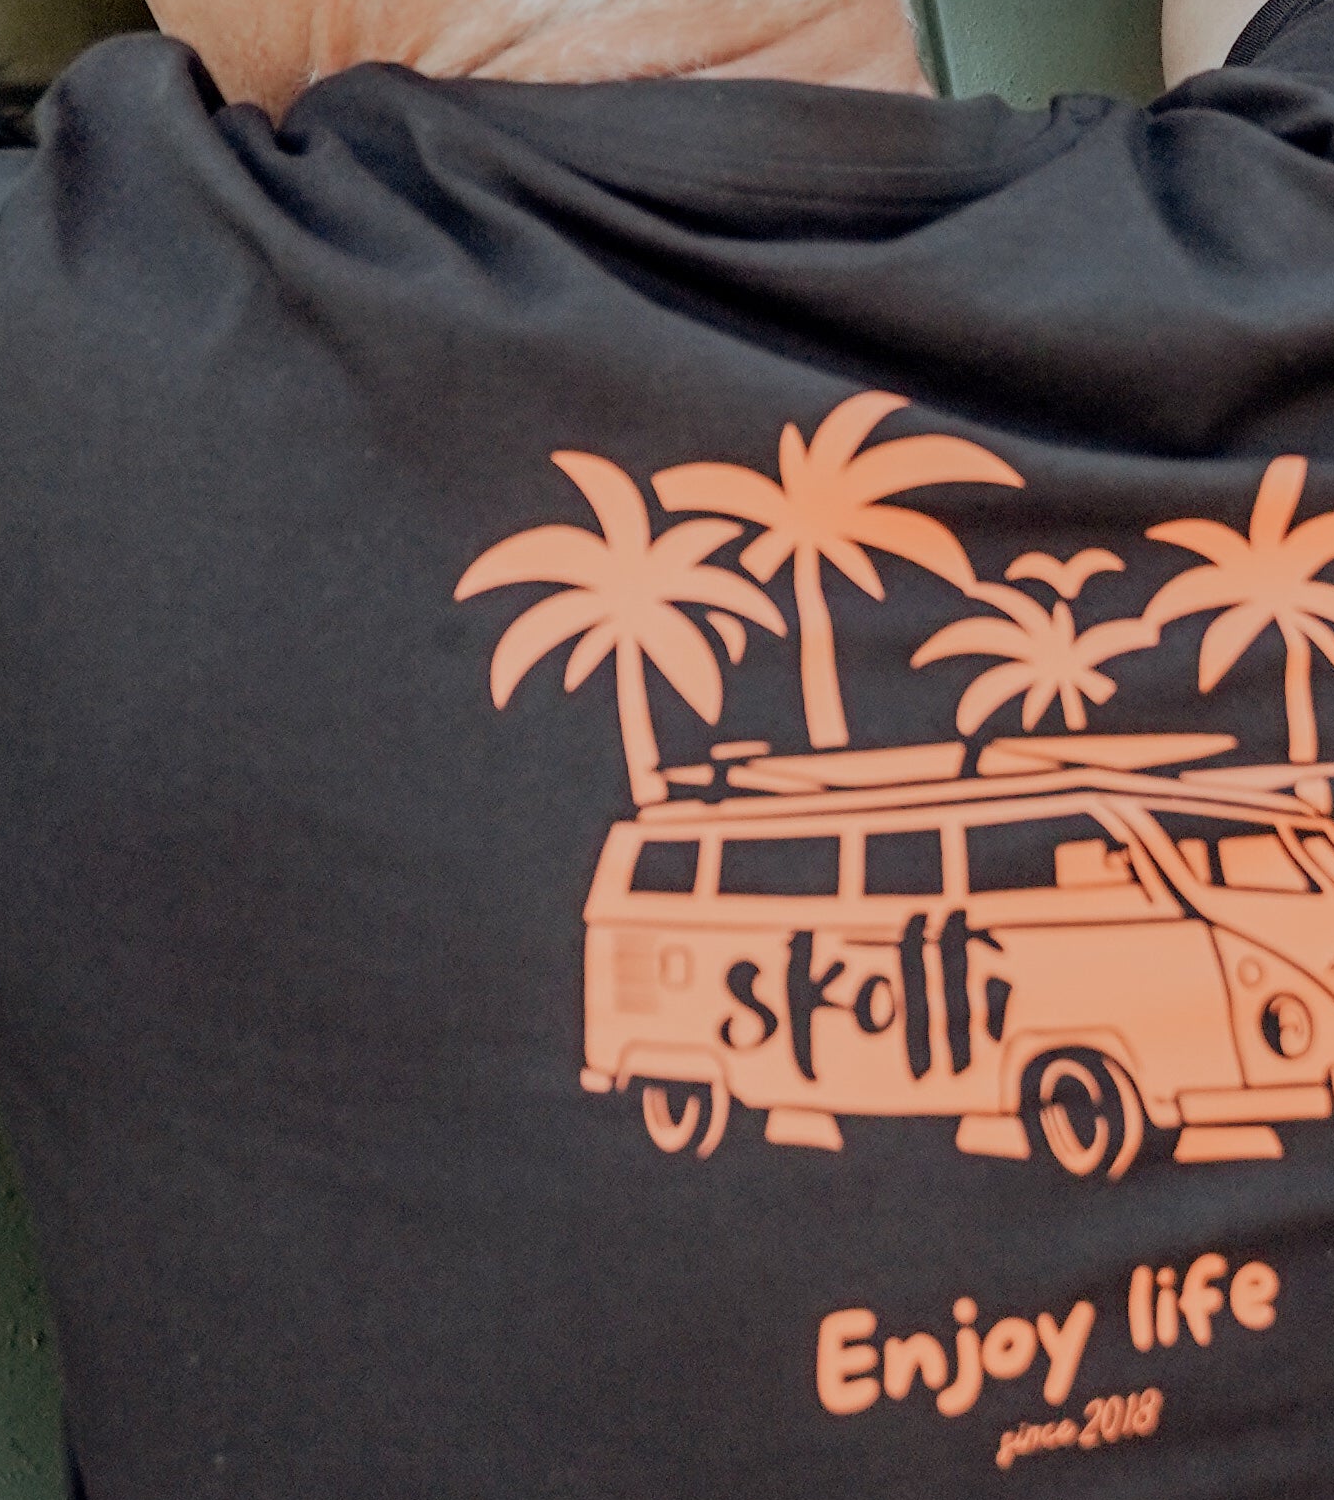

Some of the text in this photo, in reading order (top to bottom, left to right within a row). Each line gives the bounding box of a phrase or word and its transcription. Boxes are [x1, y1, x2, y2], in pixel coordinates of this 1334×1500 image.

[816, 1251, 1281, 1418] Enjoy life
[995, 1386, 1165, 1470] since 2018
